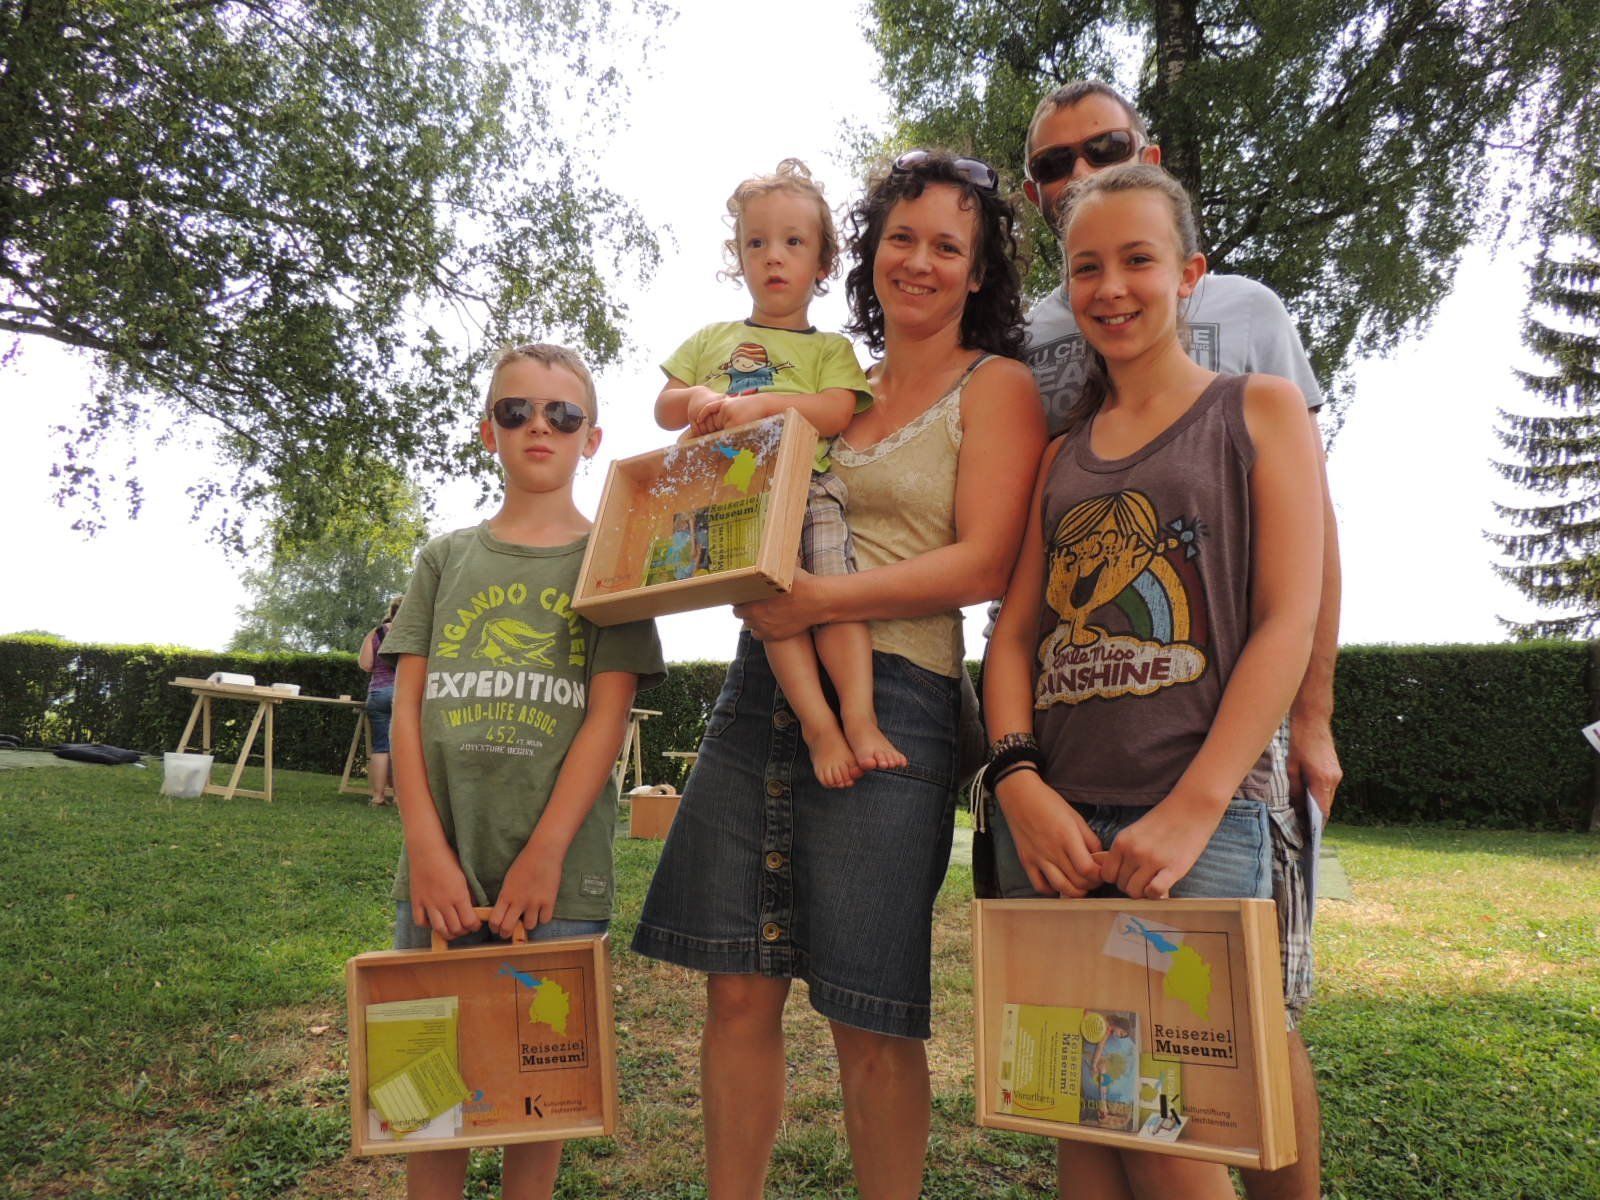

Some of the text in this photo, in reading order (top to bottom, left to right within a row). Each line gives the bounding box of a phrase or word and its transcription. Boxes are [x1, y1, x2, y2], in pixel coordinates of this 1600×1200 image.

[710, 503, 760, 521] Museum!
[436, 583, 528, 659] NGANDO
[426, 671, 586, 709] EXPEDITION
[447, 702, 557, 737] WILD-LIFE ASSOC.
[486, 725, 516, 744] 452
[1154, 1024, 1233, 1043] Reiseziel
[521, 1040, 584, 1055] Reiseziel
[1156, 1040, 1233, 1059] Museum!
[522, 1052, 585, 1066] Museum!
[1060, 1032, 1071, 1096] Museum!
